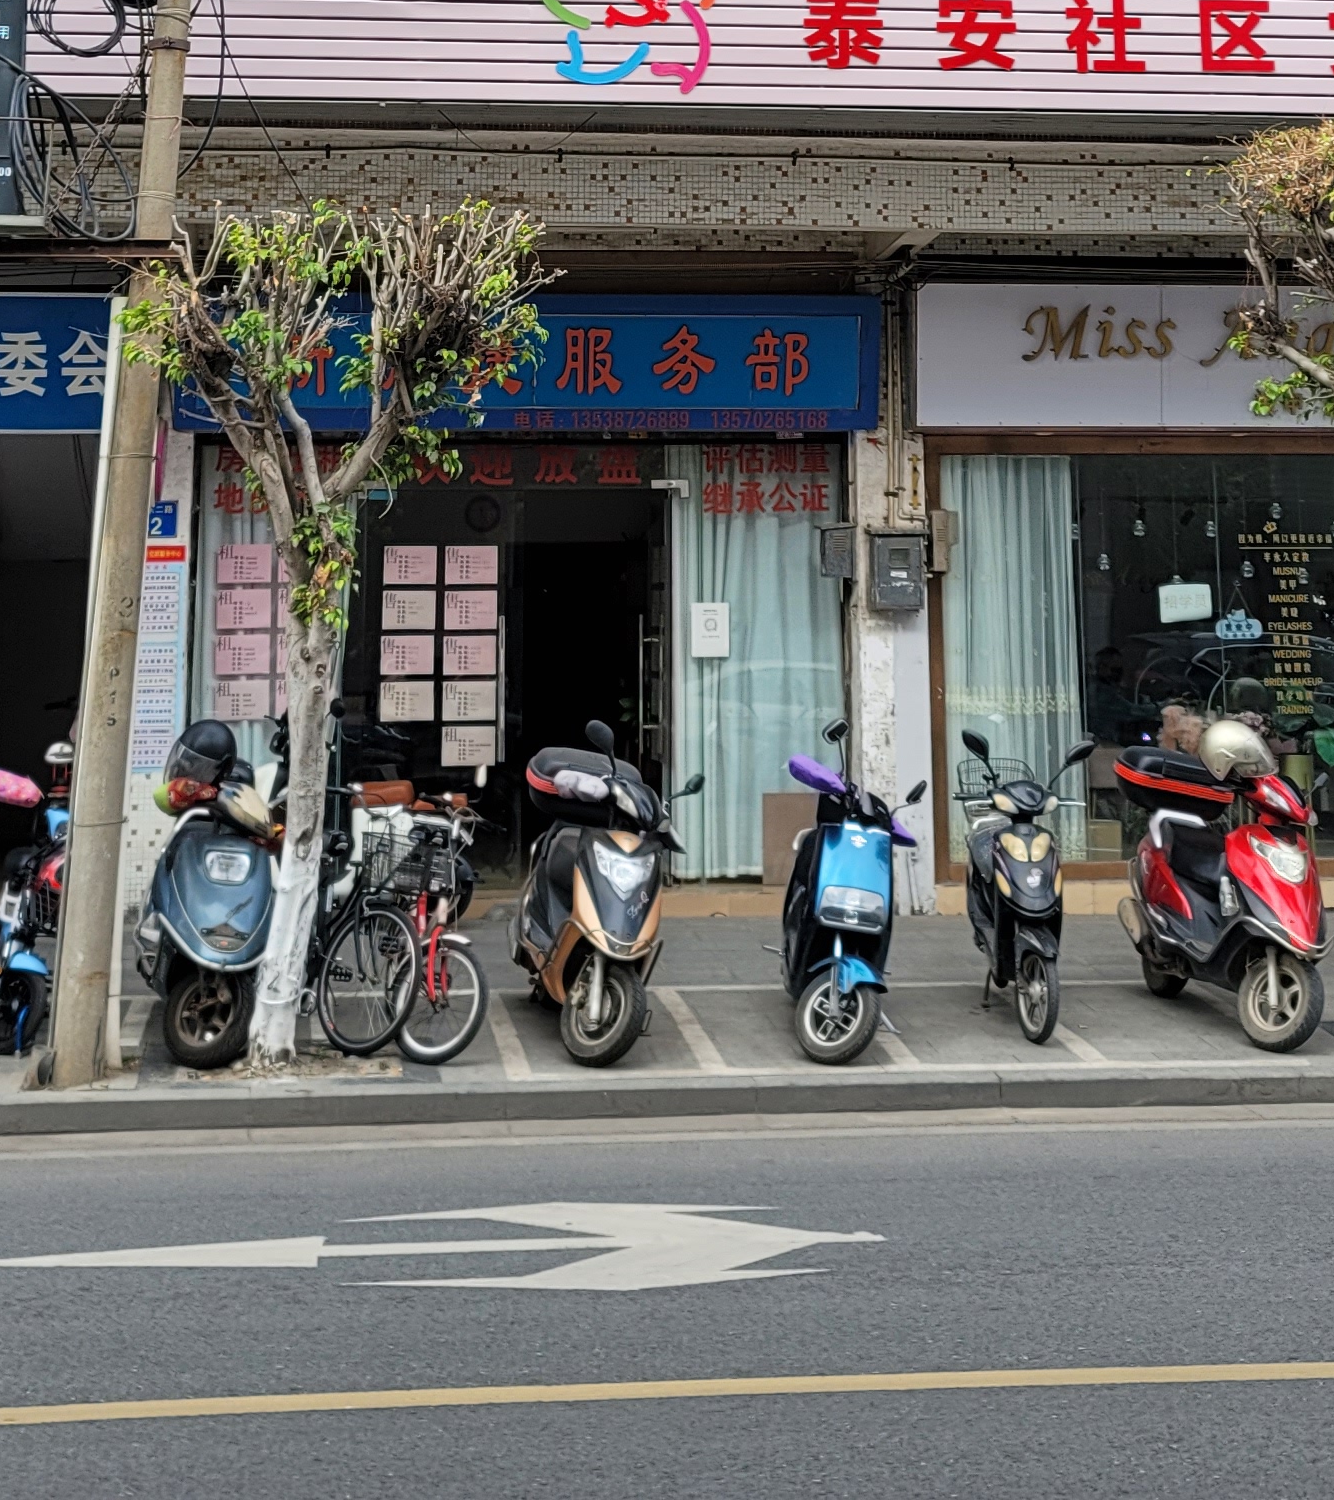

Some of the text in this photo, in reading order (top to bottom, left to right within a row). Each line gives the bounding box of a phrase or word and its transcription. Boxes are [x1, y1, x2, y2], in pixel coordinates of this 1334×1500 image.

[1022, 304, 1176, 362] Miss
[702, 443, 831, 474] 评估测量
[703, 482, 831, 514] 继承公证
[219, 545, 235, 560] 租
[218, 590, 233, 605] 租
[1268, 594, 1309, 603] MANICURE
[1268, 622, 1313, 630] EYELASHES
[217, 636, 232, 651] 租
[1273, 650, 1312, 658] WEDDING
[1264, 677, 1323, 686] BRIDE MAKEUP
[217, 683, 231, 697] 租
[1277, 706, 1314, 714] TRAINING
